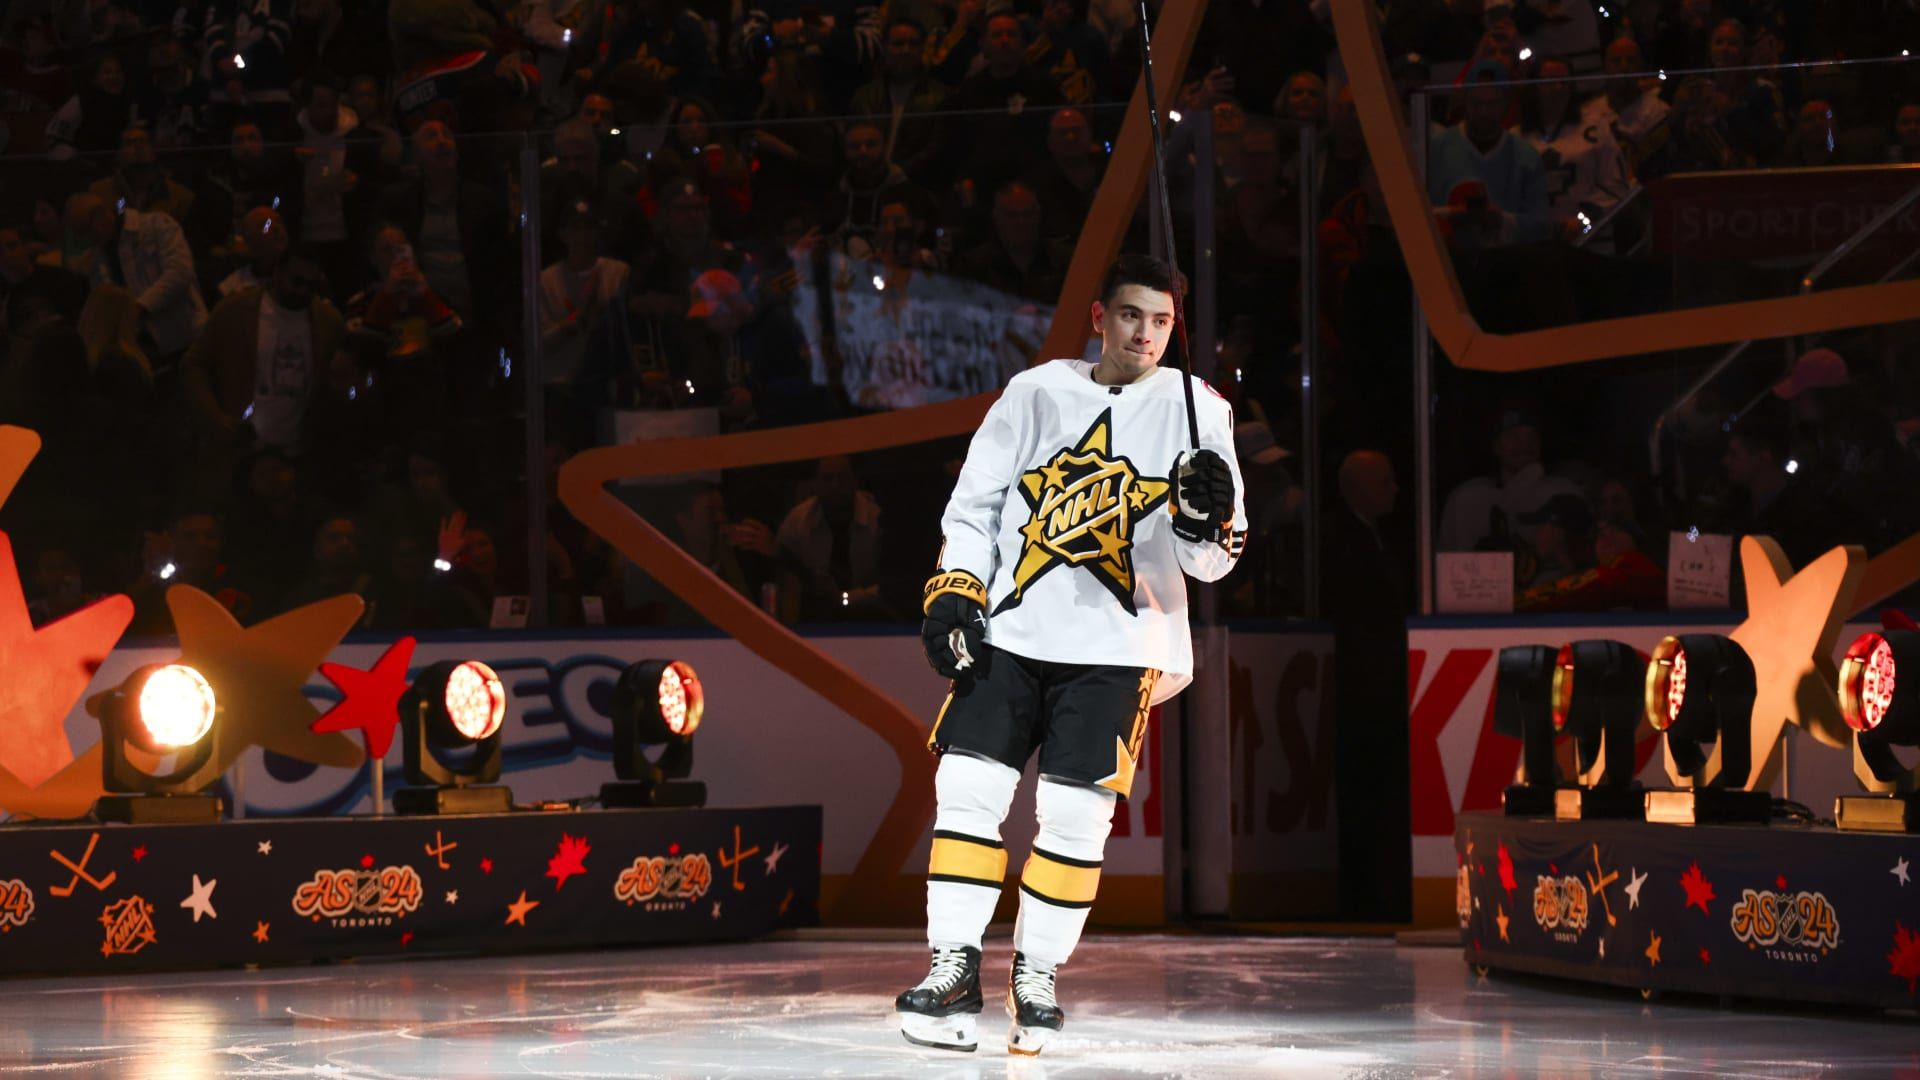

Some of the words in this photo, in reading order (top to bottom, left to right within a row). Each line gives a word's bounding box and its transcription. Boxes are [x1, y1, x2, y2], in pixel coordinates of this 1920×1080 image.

[1048, 478, 1117, 537] NHL
[924, 577, 982, 597] AUER
[296, 870, 354, 913] AS
[382, 867, 420, 908] 24
[331, 917, 393, 928] TORONTO
[1733, 891, 1777, 944] AS
[1800, 894, 1838, 946] 24
[1765, 950, 1819, 963] TORONTO
